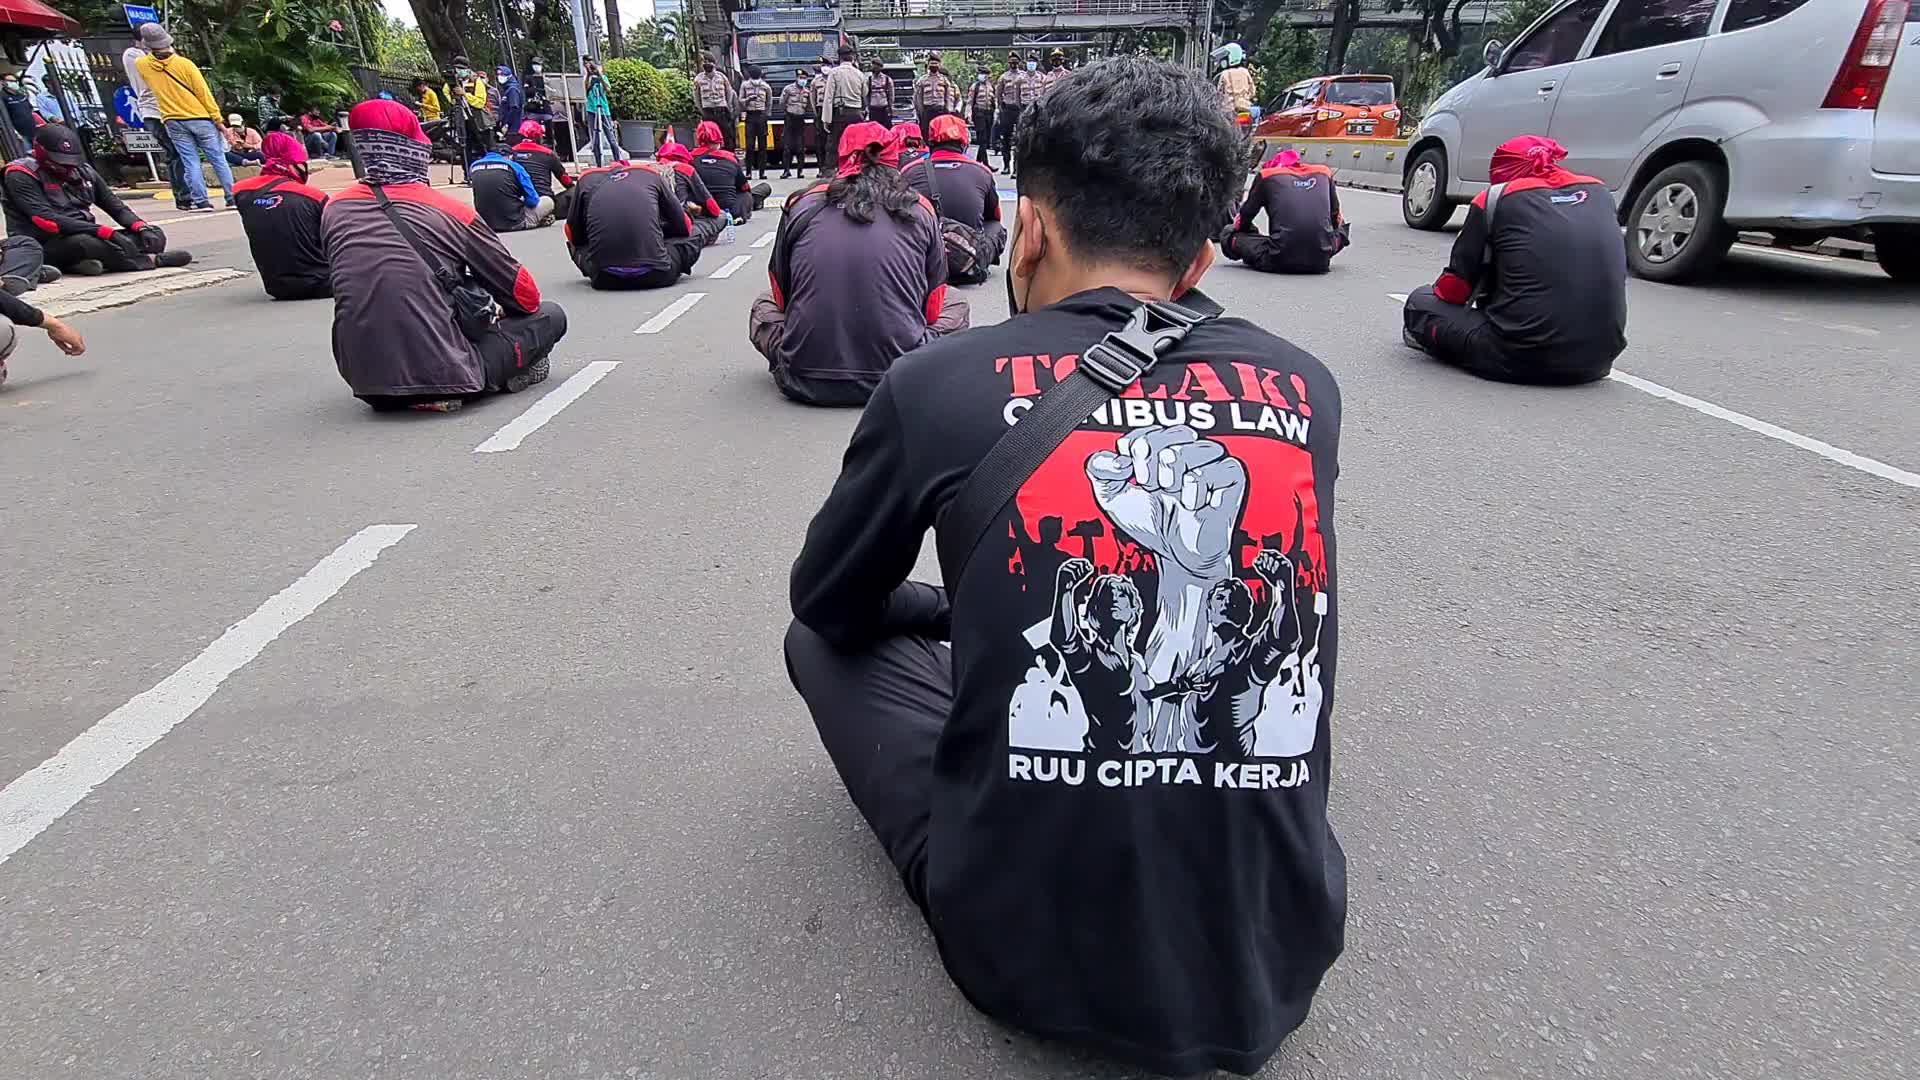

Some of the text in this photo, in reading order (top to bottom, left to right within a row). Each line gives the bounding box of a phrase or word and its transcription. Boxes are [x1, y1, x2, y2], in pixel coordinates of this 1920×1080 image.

[128, 9, 155, 21] MASUK
[799, 32, 823, 42] JAKPUS
[1002, 397, 1310, 445] ONIBUS LAW
[1008, 754, 1311, 790] RUU CIPTA KERJA
